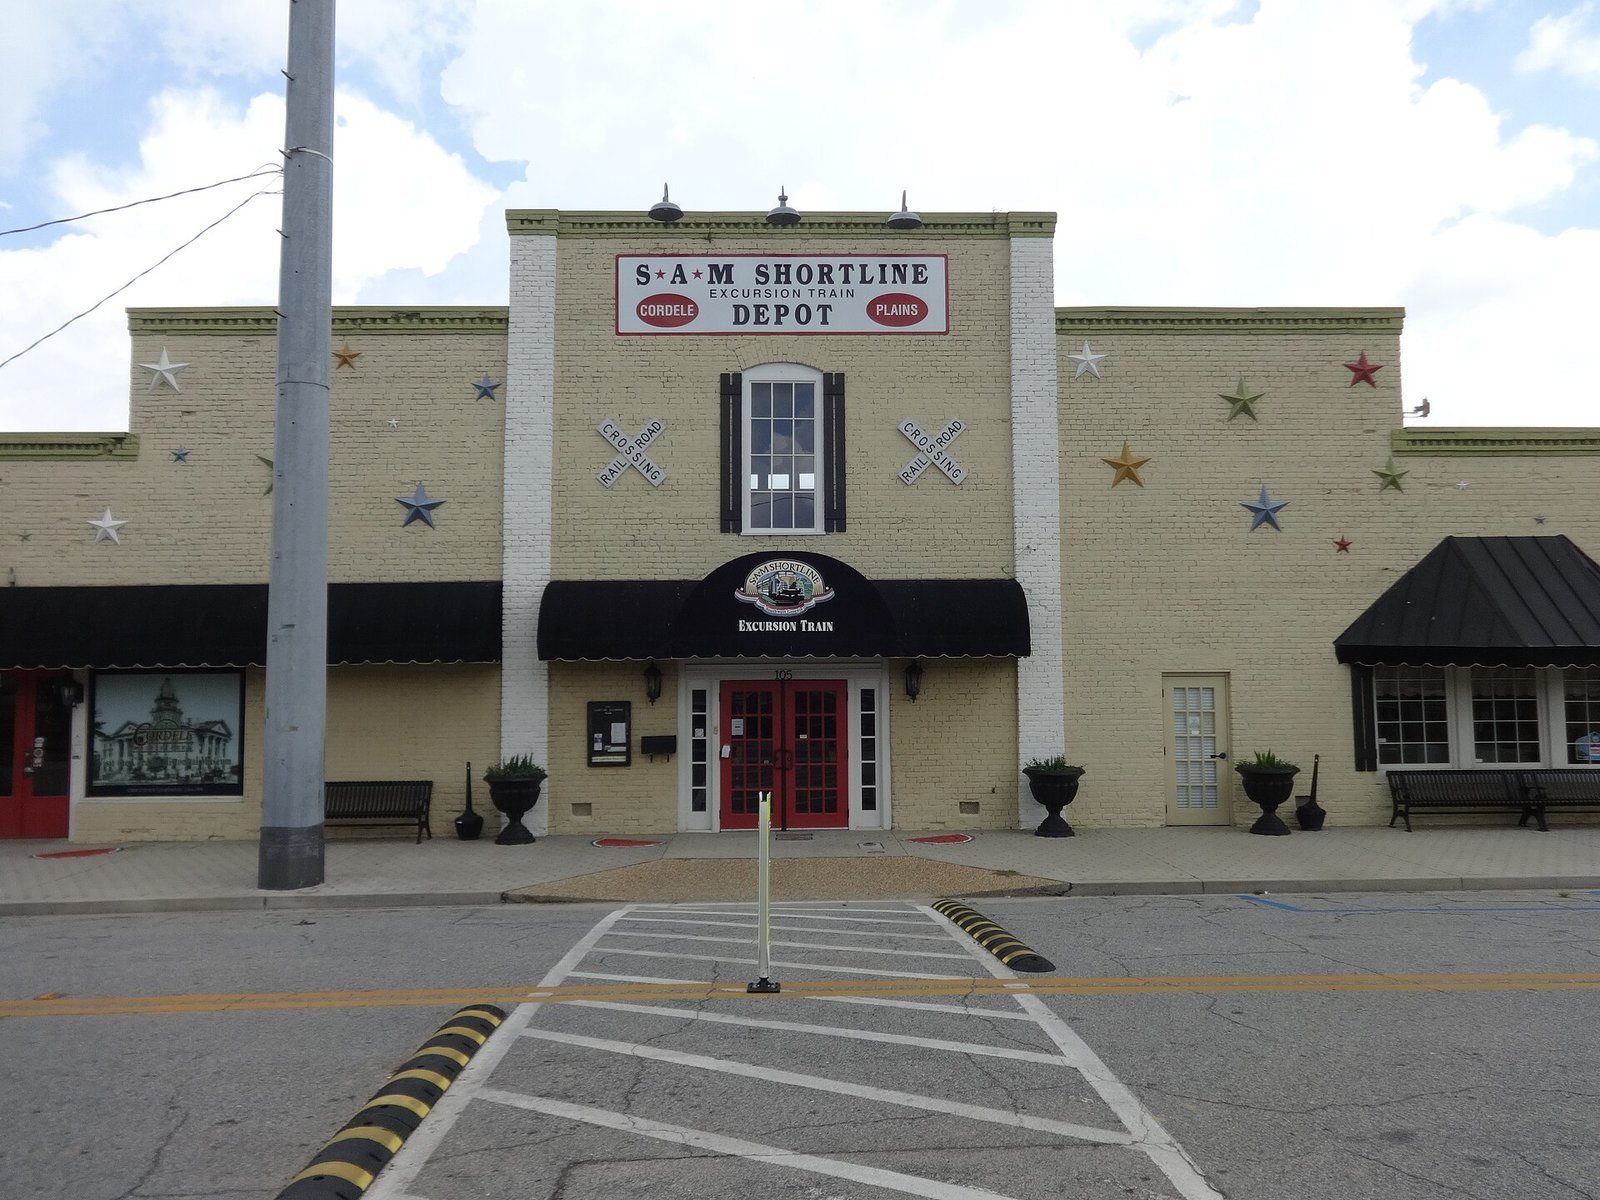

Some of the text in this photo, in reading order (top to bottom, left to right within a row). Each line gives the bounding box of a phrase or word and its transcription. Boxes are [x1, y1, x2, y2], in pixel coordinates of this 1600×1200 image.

[755, 263, 929, 286] SHORTLINE
[709, 288, 855, 299] EXCURSION TRAIN
[640, 304, 695, 317] CORDELE
[732, 304, 833, 326] DEPOT
[876, 304, 919, 317] PLAINS
[602, 423, 661, 481] CROSSING
[903, 422, 962, 479] CROSSING
[769, 562, 821, 585] SHORTLINE
[775, 669, 793, 681] 105
